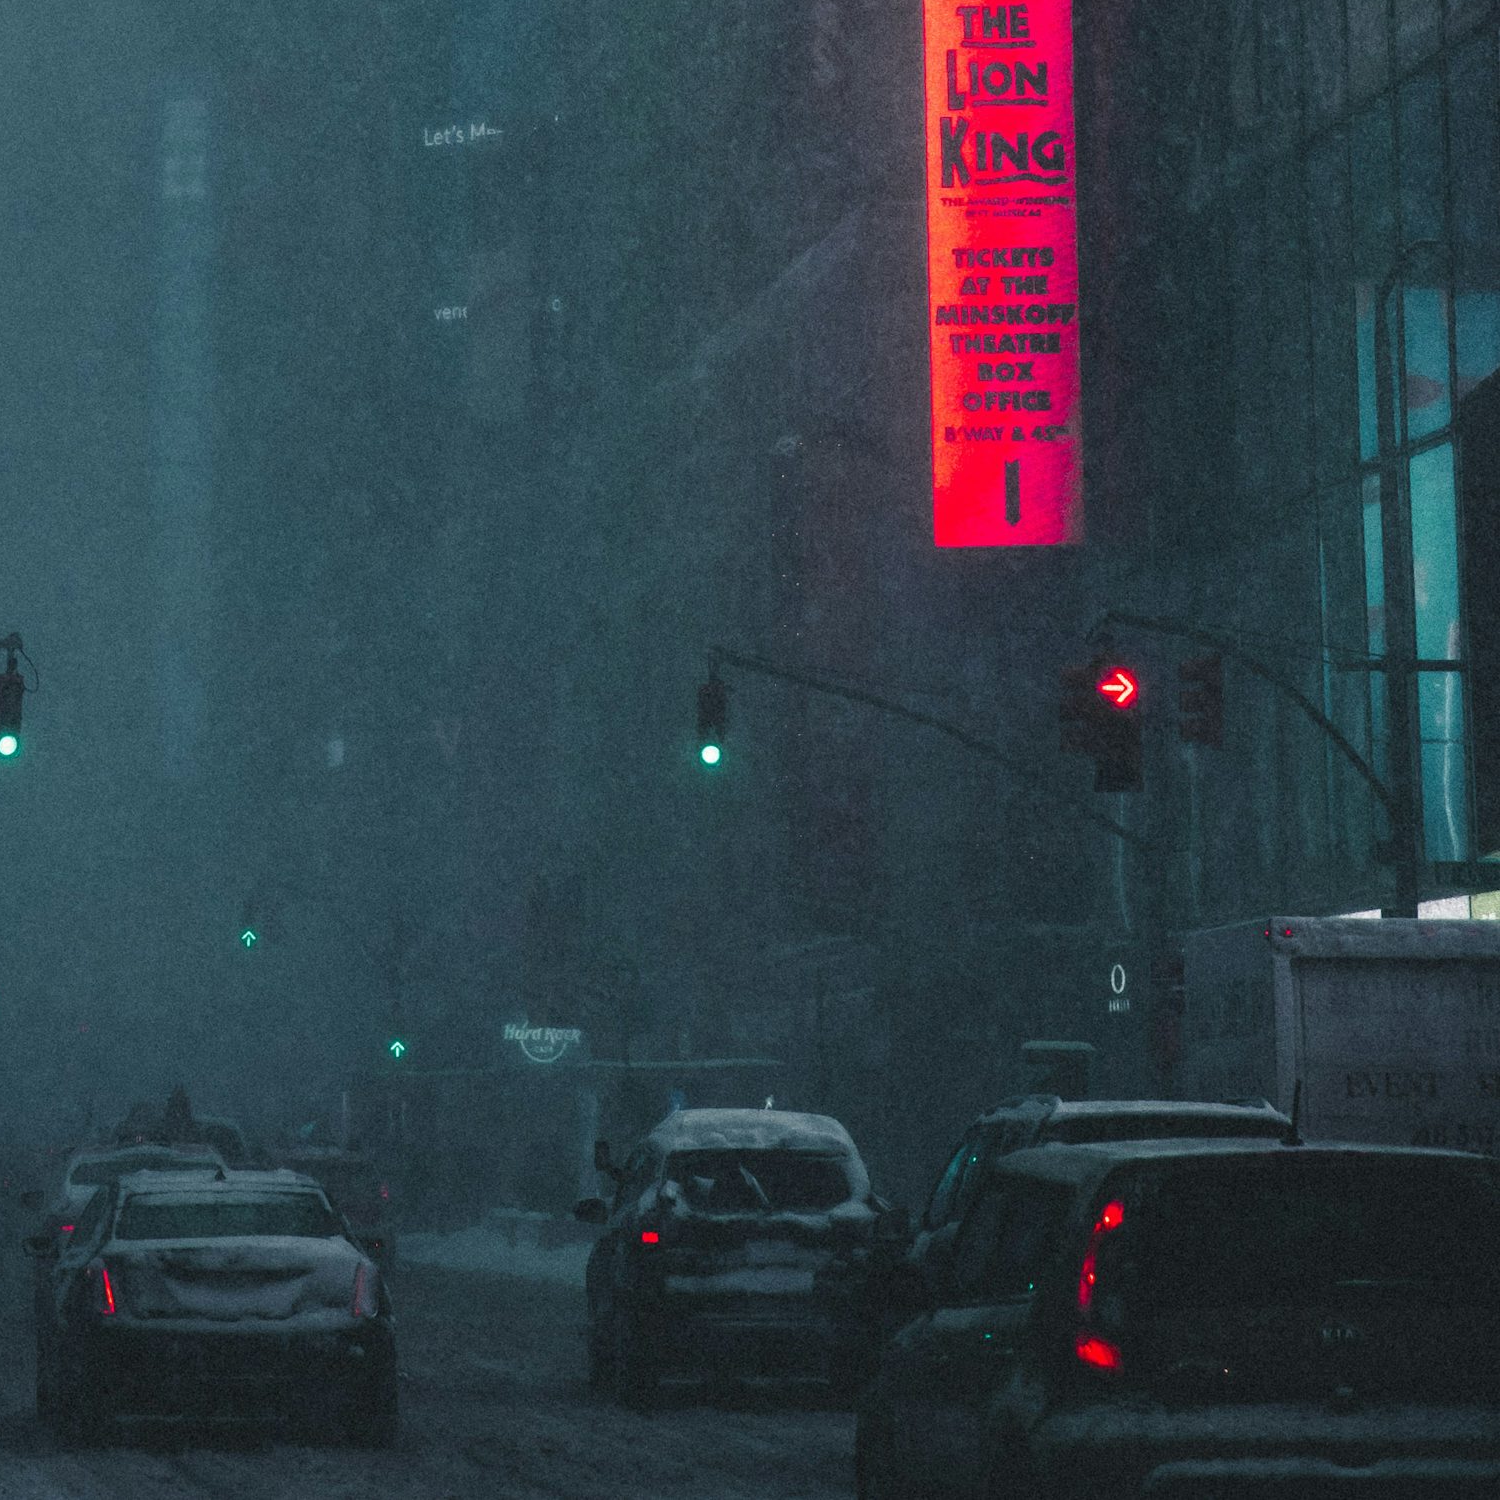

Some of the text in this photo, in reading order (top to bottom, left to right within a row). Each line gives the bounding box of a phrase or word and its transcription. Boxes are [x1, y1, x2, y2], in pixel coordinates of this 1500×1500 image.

[956, 4, 1029, 38] THE
[947, 49, 1047, 110] LION
[424, 125, 464, 147] Let's
[940, 117, 1065, 188] KING
[952, 247, 1055, 268] TICKETS
[960, 276, 1048, 295] AT THE
[936, 303, 1077, 325] MINSKOFF
[951, 333, 1061, 354] THEATRE
[978, 363, 1034, 381] BOX
[963, 391, 1050, 411] OFFICE
[1011, 427, 1025, 442] &
